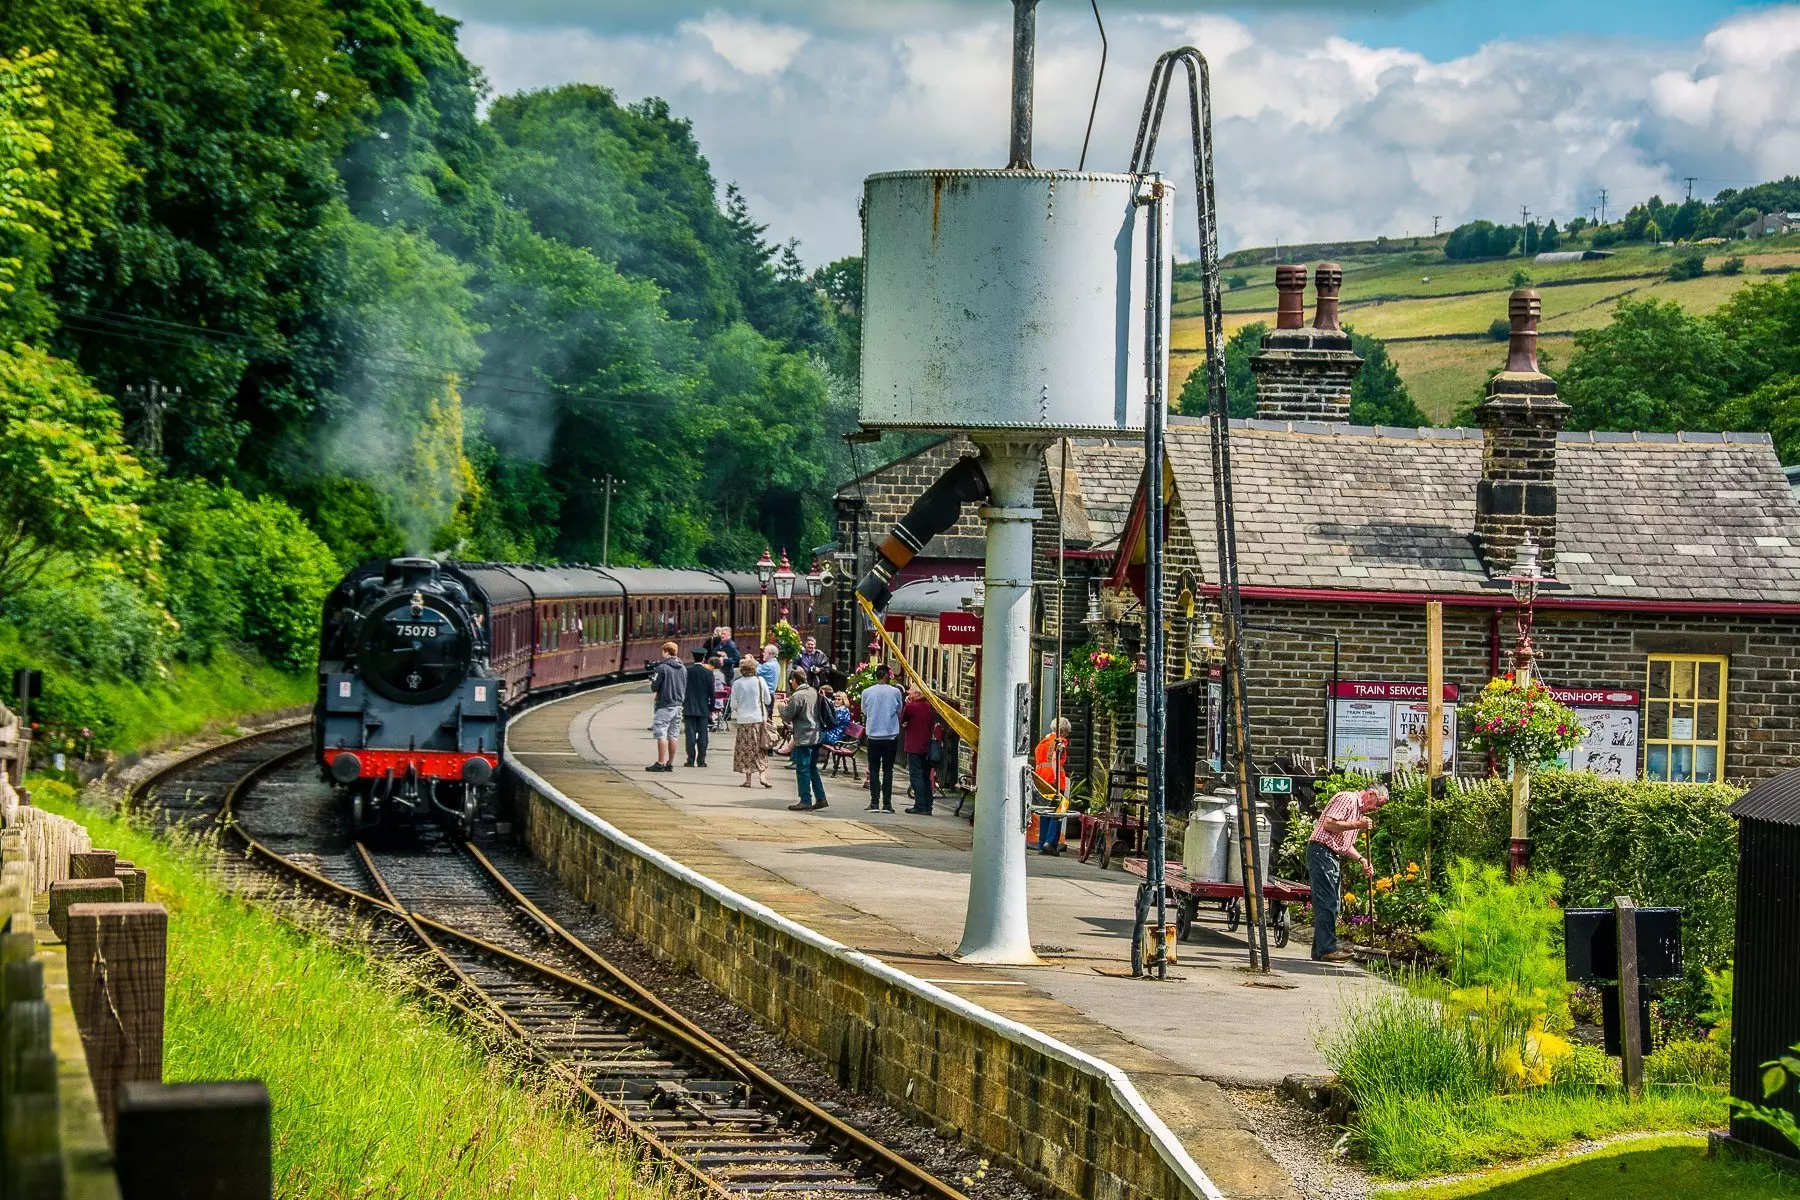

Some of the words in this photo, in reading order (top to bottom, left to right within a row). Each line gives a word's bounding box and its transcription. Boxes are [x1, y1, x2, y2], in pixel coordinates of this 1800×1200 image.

[396, 625, 437, 637] 75078
[1353, 685, 1385, 695] TRAIN
[1389, 686, 1428, 696] SERVICE
[1548, 691, 1604, 702] OXENHOPE
[1400, 712, 1450, 724] VINTE
[1400, 723, 1449, 736] TRAS
